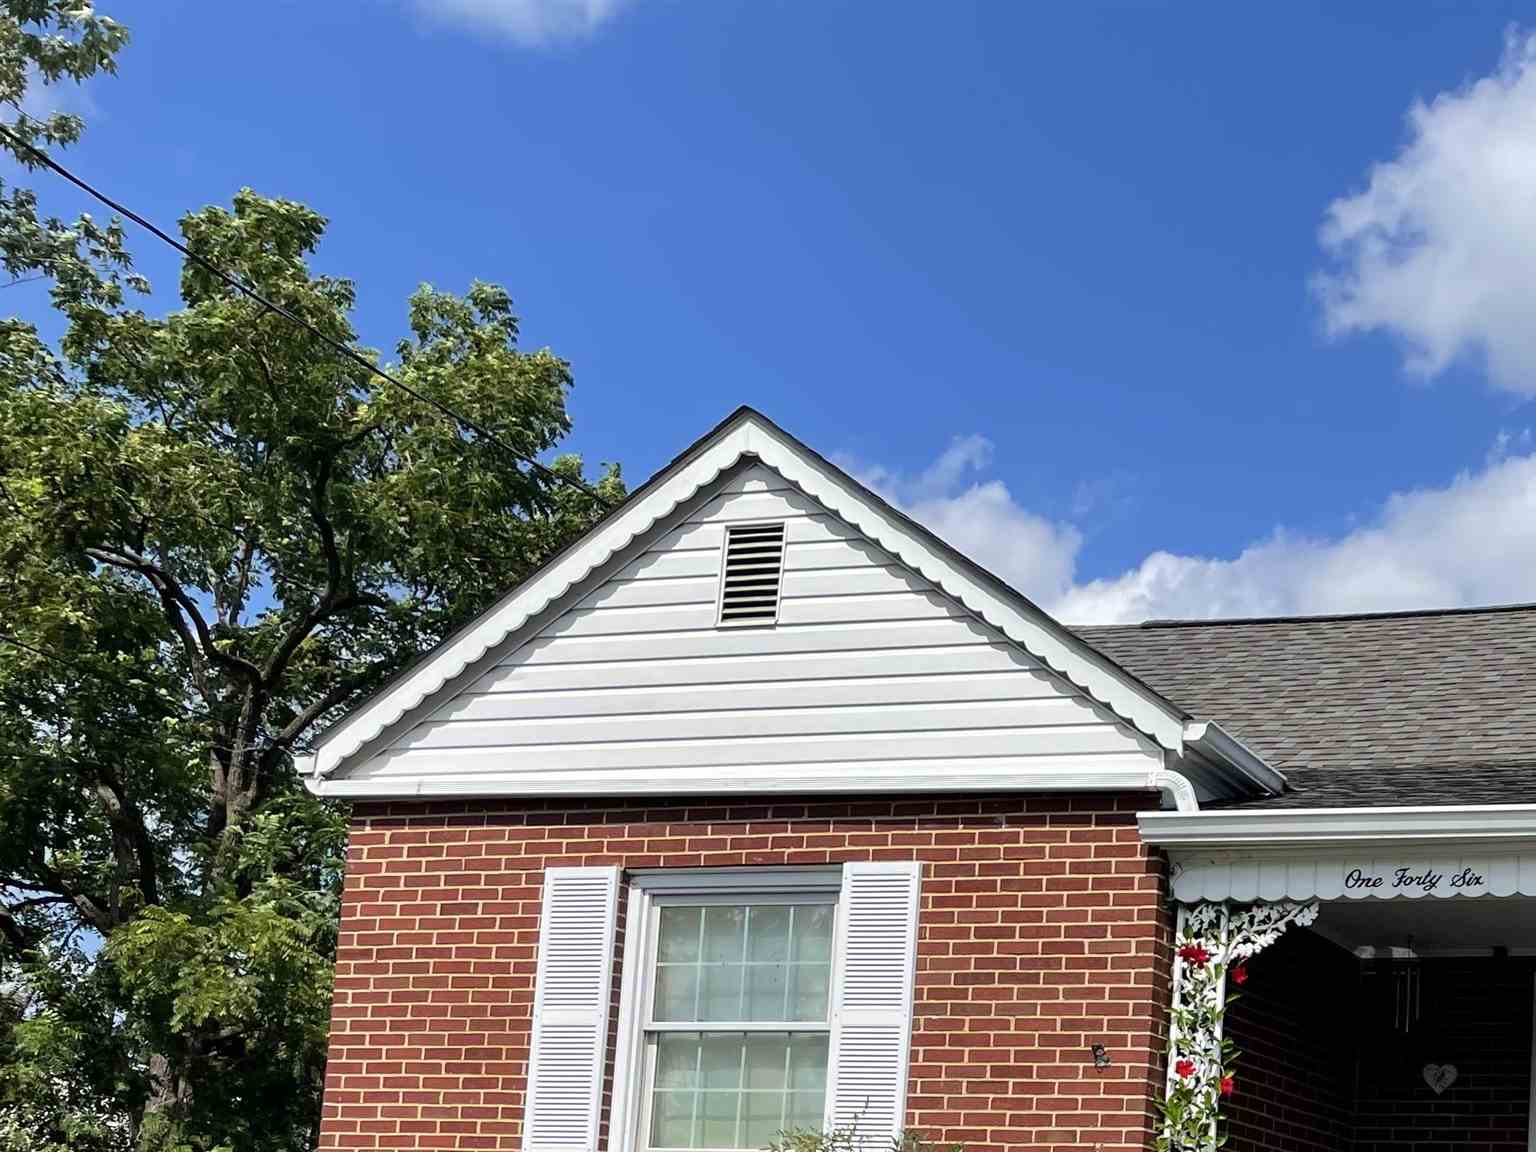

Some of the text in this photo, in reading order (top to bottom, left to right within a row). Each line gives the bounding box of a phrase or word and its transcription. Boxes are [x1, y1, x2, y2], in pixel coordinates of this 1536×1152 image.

[1345, 867, 1484, 891] One Forty Six
